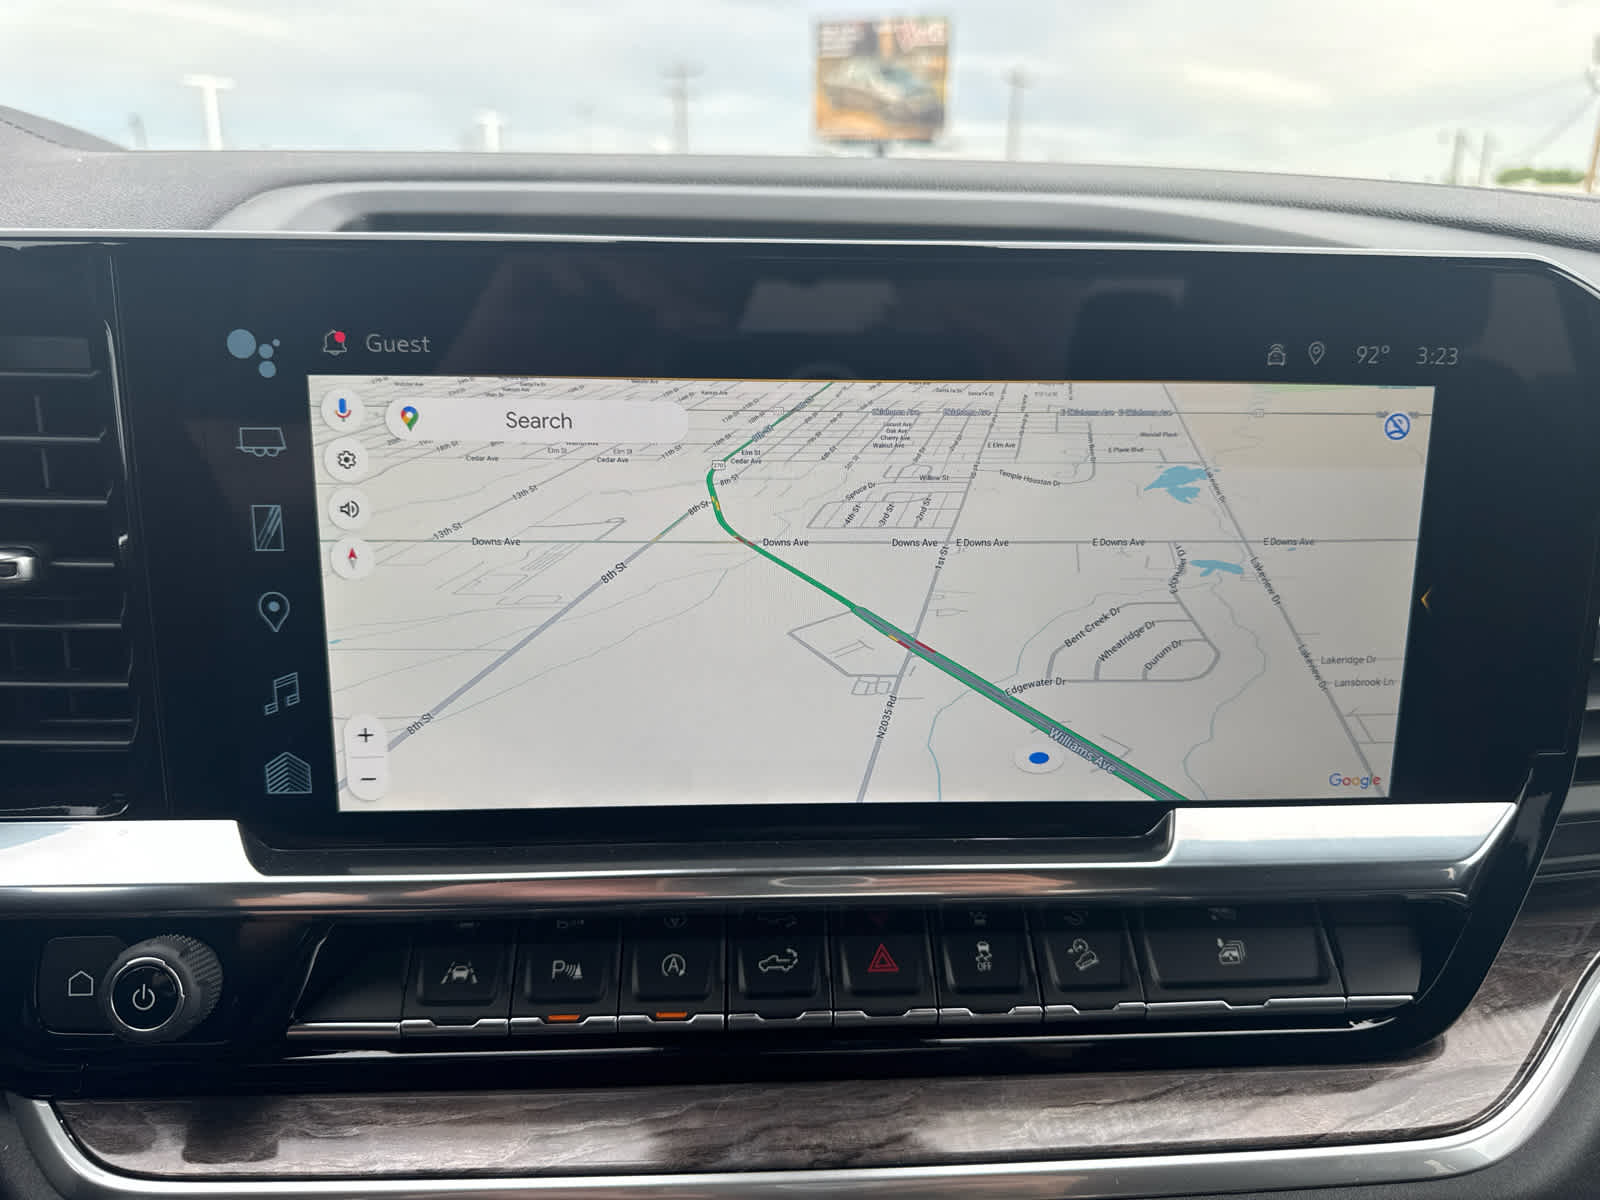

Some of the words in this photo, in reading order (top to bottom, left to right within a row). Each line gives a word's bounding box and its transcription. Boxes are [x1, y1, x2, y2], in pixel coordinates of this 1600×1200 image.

[366, 334, 431, 352] Guest
[1356, 345, 1390, 364] 92°
[1415, 346, 1459, 365] 3:23
[505, 411, 574, 430] Search
[880, 435, 899, 443] Cherry
[597, 456, 616, 464] Cedar
[741, 449, 753, 457] Elm
[720, 477, 732, 487] 8th
[730, 472, 740, 482] St
[919, 473, 941, 481] Willow
[942, 473, 951, 481] St
[1000, 469, 1023, 481] Temple
[1023, 474, 1053, 486] Houston
[1053, 479, 1063, 487] Dr
[513, 487, 530, 502] 13th
[528, 483, 539, 494] St
[846, 484, 868, 502] Spruce
[867, 481, 877, 490] Dr
[687, 502, 702, 516] 8th
[699, 499, 711, 510] St
[922, 497, 932, 508] St
[844, 512, 857, 526] 4th
[852, 502, 863, 514] St
[878, 510, 891, 527] 3rd
[886, 502, 896, 514] St
[916, 505, 929, 521] 2nd
[432, 527, 453, 541] 13th
[451, 521, 464, 533] St
[471, 537, 503, 547] Downs
[504, 537, 522, 547] Ave
[762, 537, 791, 548] Downs
[792, 537, 810, 548] Ave
[892, 537, 921, 548] Downs
[921, 537, 939, 548] Ave
[956, 538, 963, 547] E
[963, 538, 992, 547] Downs
[993, 538, 1009, 547] Ave
[1092, 538, 1099, 547] E
[1099, 538, 1129, 547] Downs
[1129, 538, 1145, 547] Ave
[1263, 537, 1270, 546] E
[1270, 537, 1298, 546] Downs
[1299, 537, 1316, 546] Ave
[939, 544, 949, 558] St
[935, 557, 946, 570] 1st
[600, 567, 618, 585] 8th
[614, 560, 628, 575] St
[1249, 555, 1275, 597] Lakeview
[1270, 593, 1281, 607] Dr
[1063, 631, 1086, 650] Bent
[1083, 614, 1112, 635] Creek
[1107, 605, 1121, 619] Dr
[1097, 625, 1147, 664] Wheatridge
[1143, 618, 1157, 633] Dr
[1143, 645, 1173, 673] Durum
[1170, 638, 1183, 651] Dr
[1320, 655, 1364, 665] Lakeridge
[1366, 654, 1376, 664] Dr
[1004, 679, 1054, 697] Edgewater
[1054, 676, 1067, 688] Dr
[1317, 679, 1329, 694] Dr
[1334, 678, 1381, 688] Lansbrook
[406, 721, 425, 737] 8th
[420, 711, 434, 726] St
[876, 708, 893, 740] N2035
[886, 693, 898, 709] Rd
[1049, 726, 1094, 763] Williams
[1093, 755, 1116, 776] Ave
[1328, 773, 1382, 791] Google
[977, 961, 992, 972] OFF
